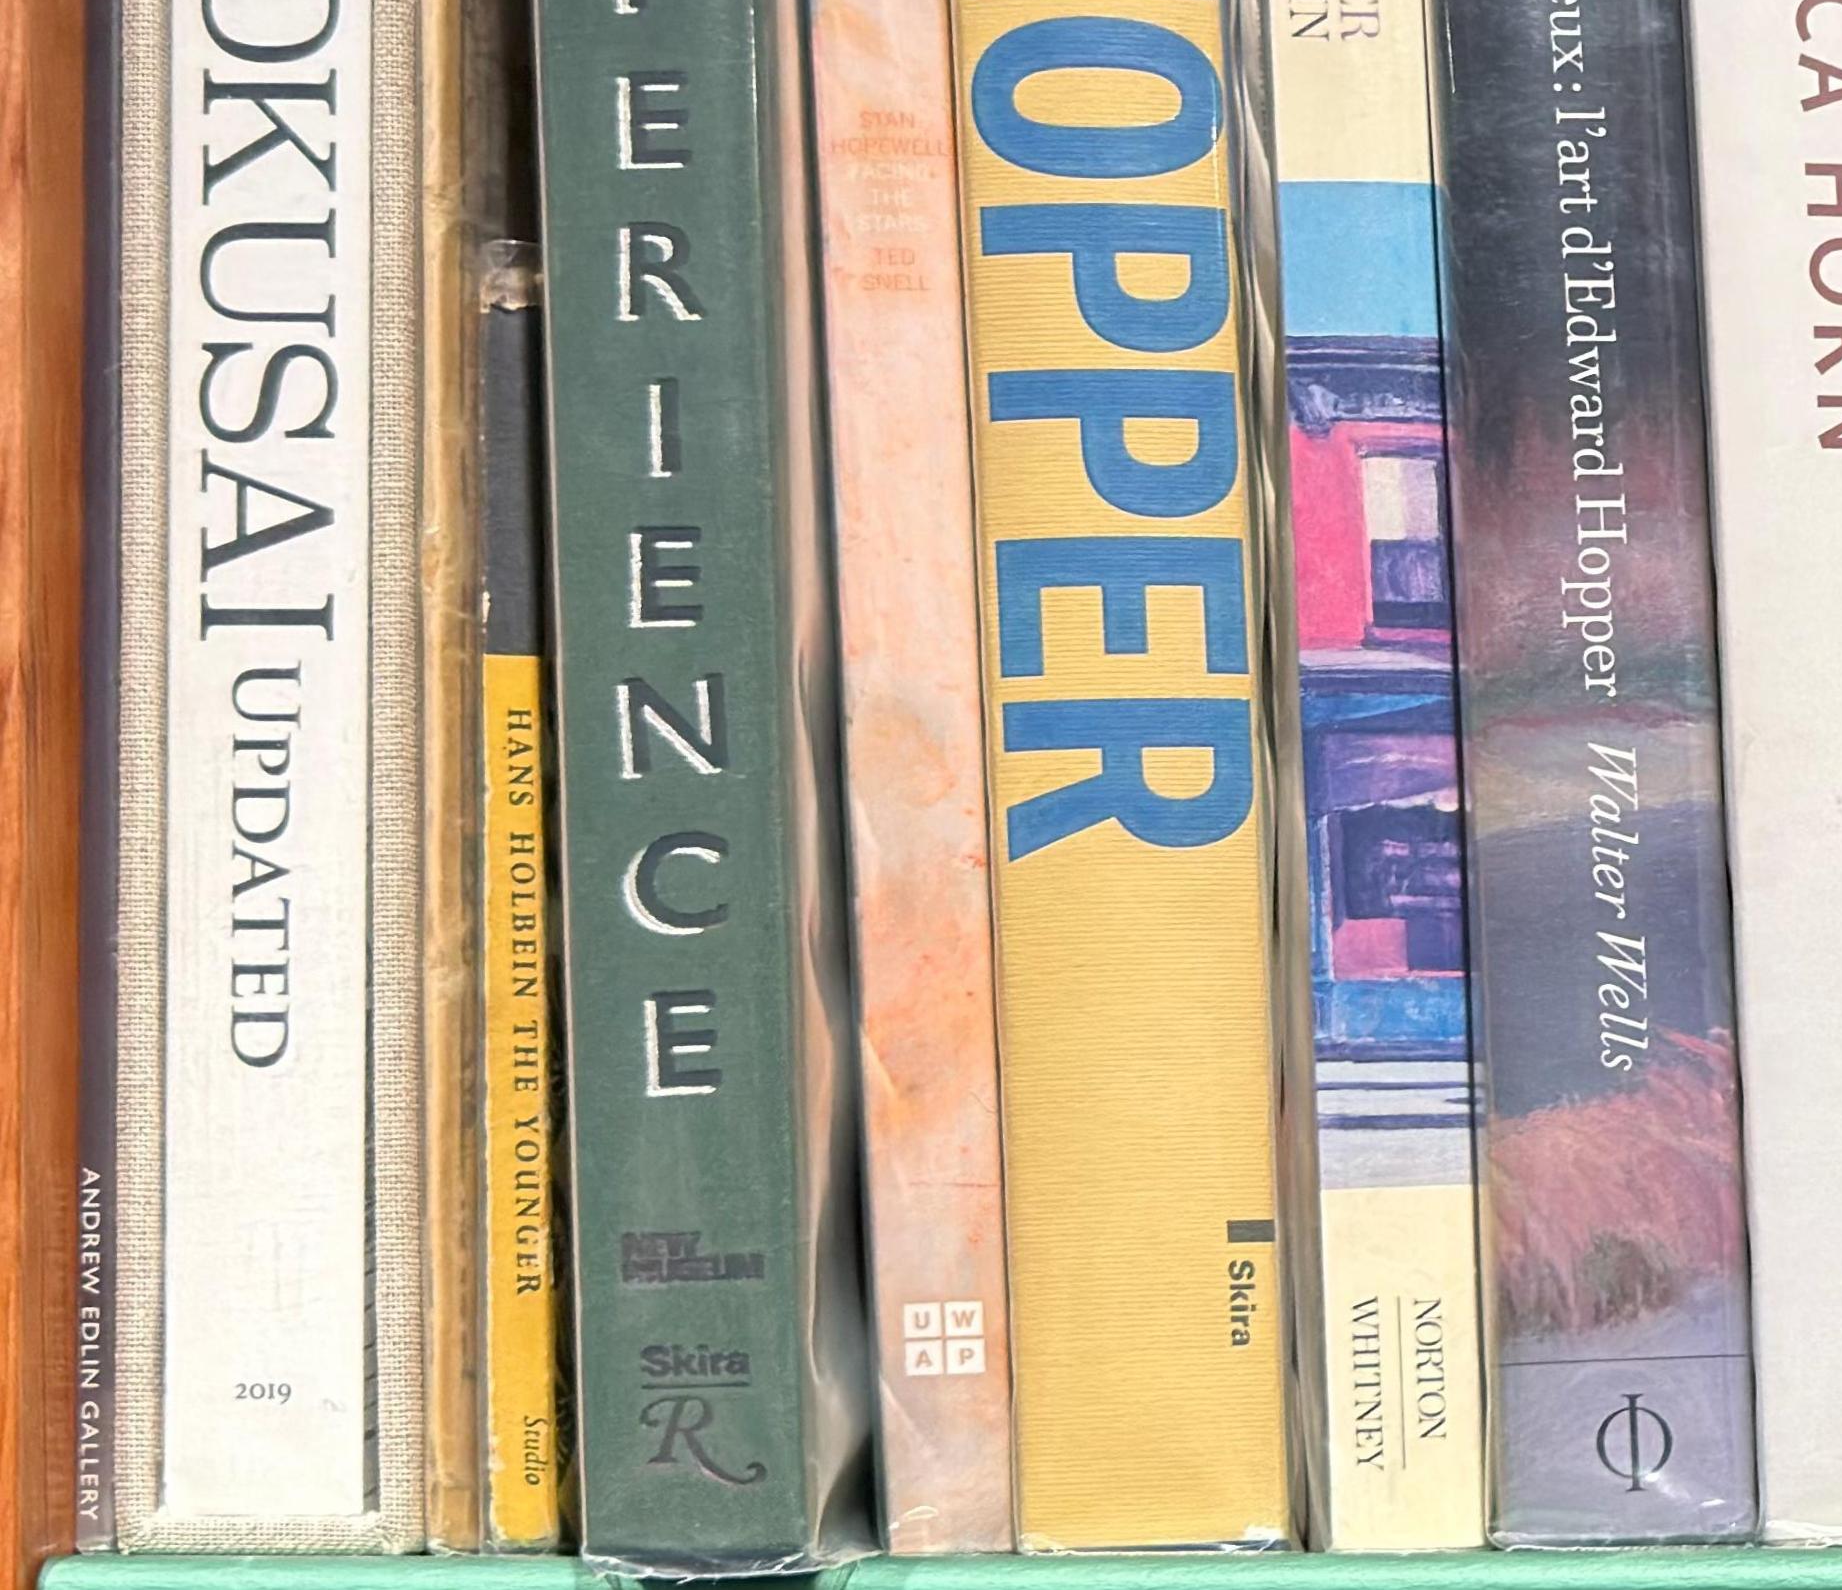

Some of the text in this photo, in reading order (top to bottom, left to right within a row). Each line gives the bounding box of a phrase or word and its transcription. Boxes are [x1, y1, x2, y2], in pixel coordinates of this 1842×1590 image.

[830, 138, 951, 156] HOPEWELL
[859, 112, 915, 129] STAN
[1555, 107, 1606, 213] l’art
[861, 273, 931, 292] SNELL
[873, 248, 915, 266] TED
[1559, 223, 1625, 481] d’Edward
[1562, 495, 1627, 698] Hopper
[231, 660, 302, 1069] UPDATED
[1587, 742, 1639, 918] Walter
[507, 709, 543, 1296] HANS HOLBEIN THE YOUNGER
[1595, 930, 1648, 1072] Wells
[79, 1167, 101, 1521] ANDREW EDLIN GALLERY
[640, 1344, 751, 1378] Skira
[1229, 1260, 1257, 1347] Skira
[235, 1383, 292, 1405] 2019
[1350, 1295, 1385, 1472] WHITNEY
[1413, 1298, 1447, 1440] NORTON
[523, 1415, 550, 1487] Studio
